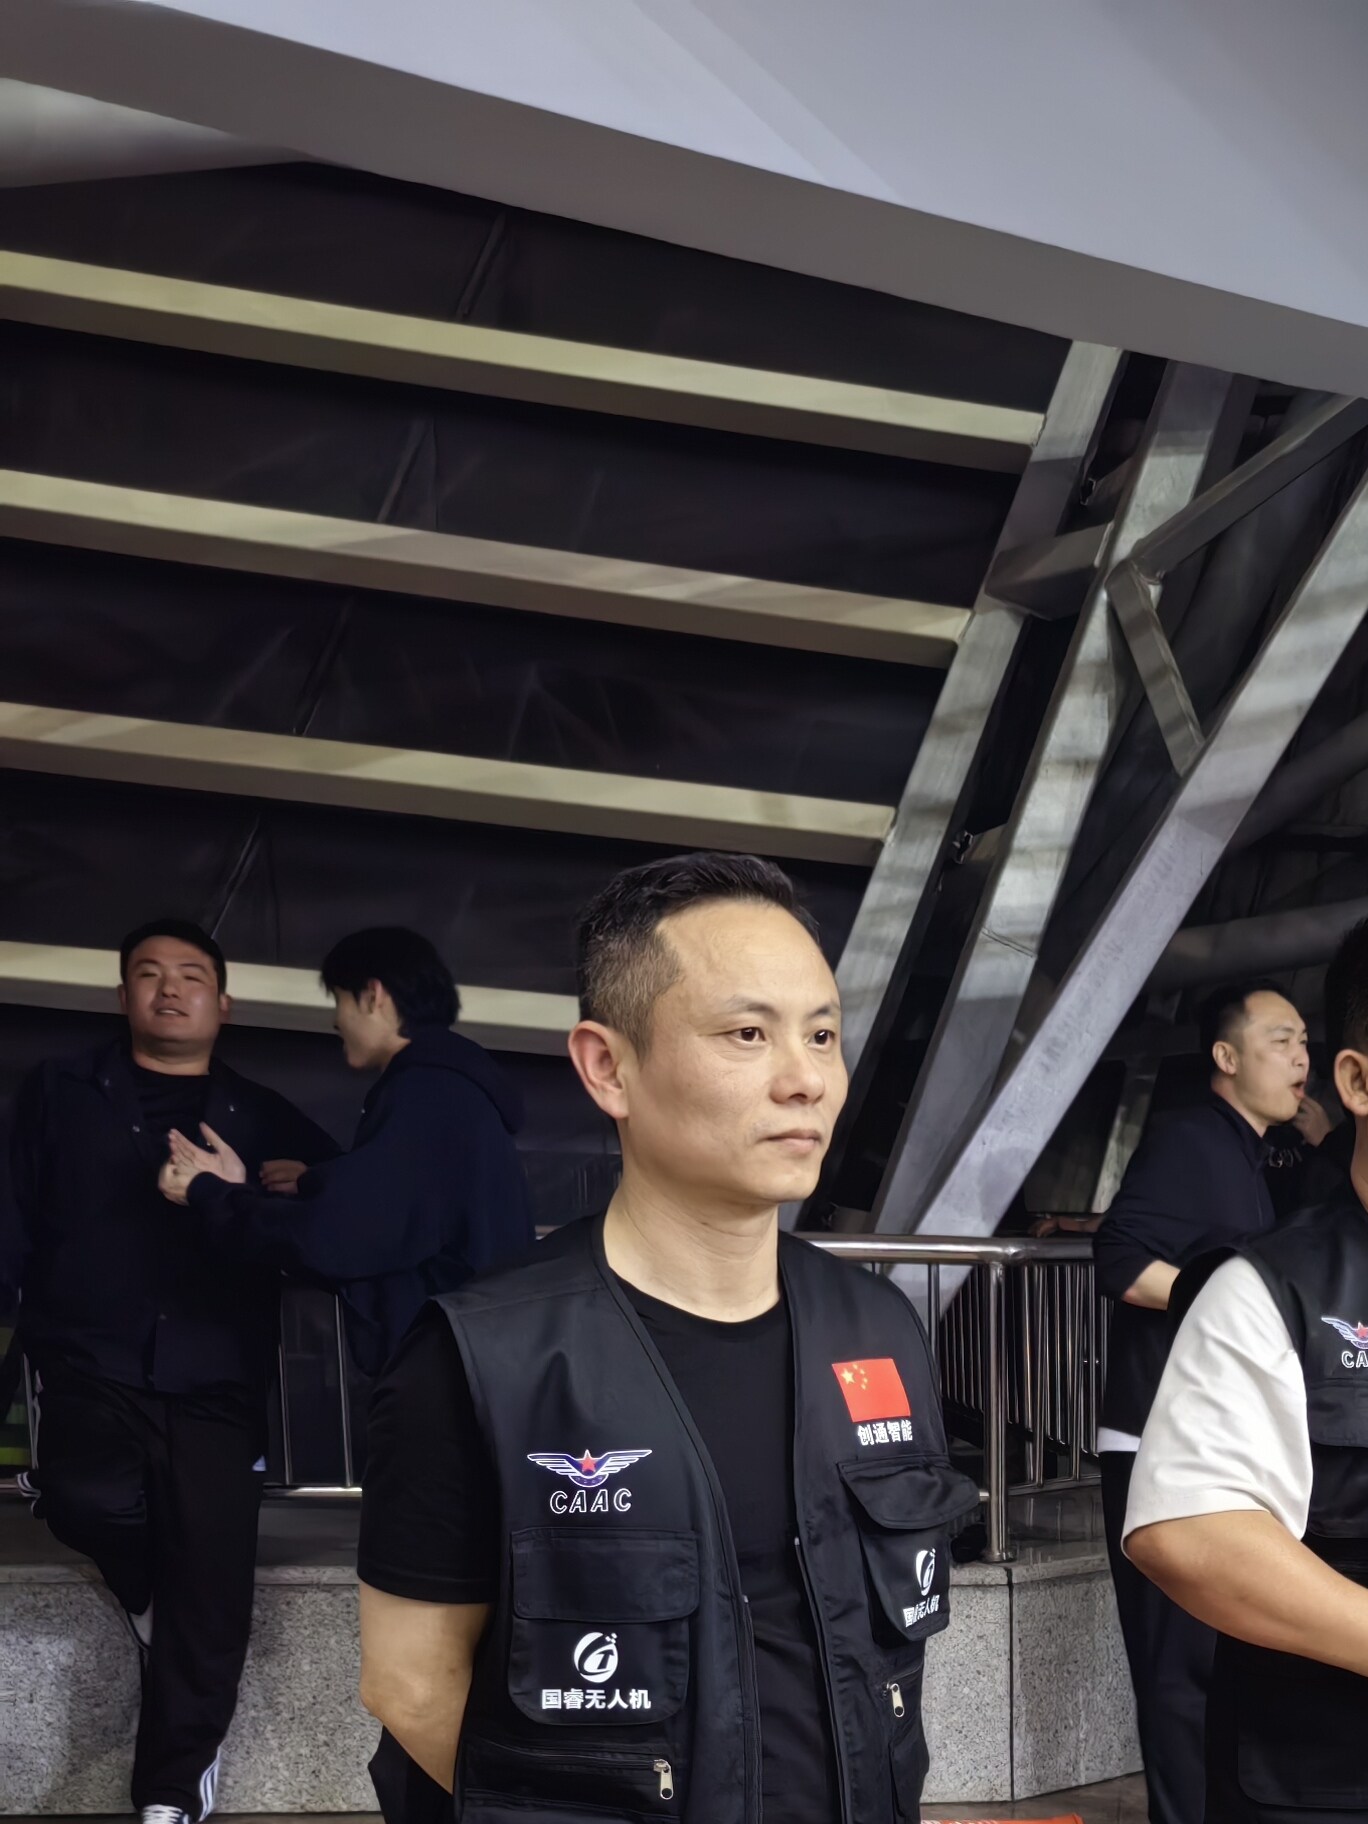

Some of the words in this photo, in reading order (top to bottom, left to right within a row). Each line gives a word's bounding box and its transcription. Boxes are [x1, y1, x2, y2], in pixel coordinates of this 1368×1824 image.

[858, 1419, 913, 1446] 创通智能
[549, 1488, 632, 1514] CAAC
[541, 1688, 652, 1710] 国睿无人机
